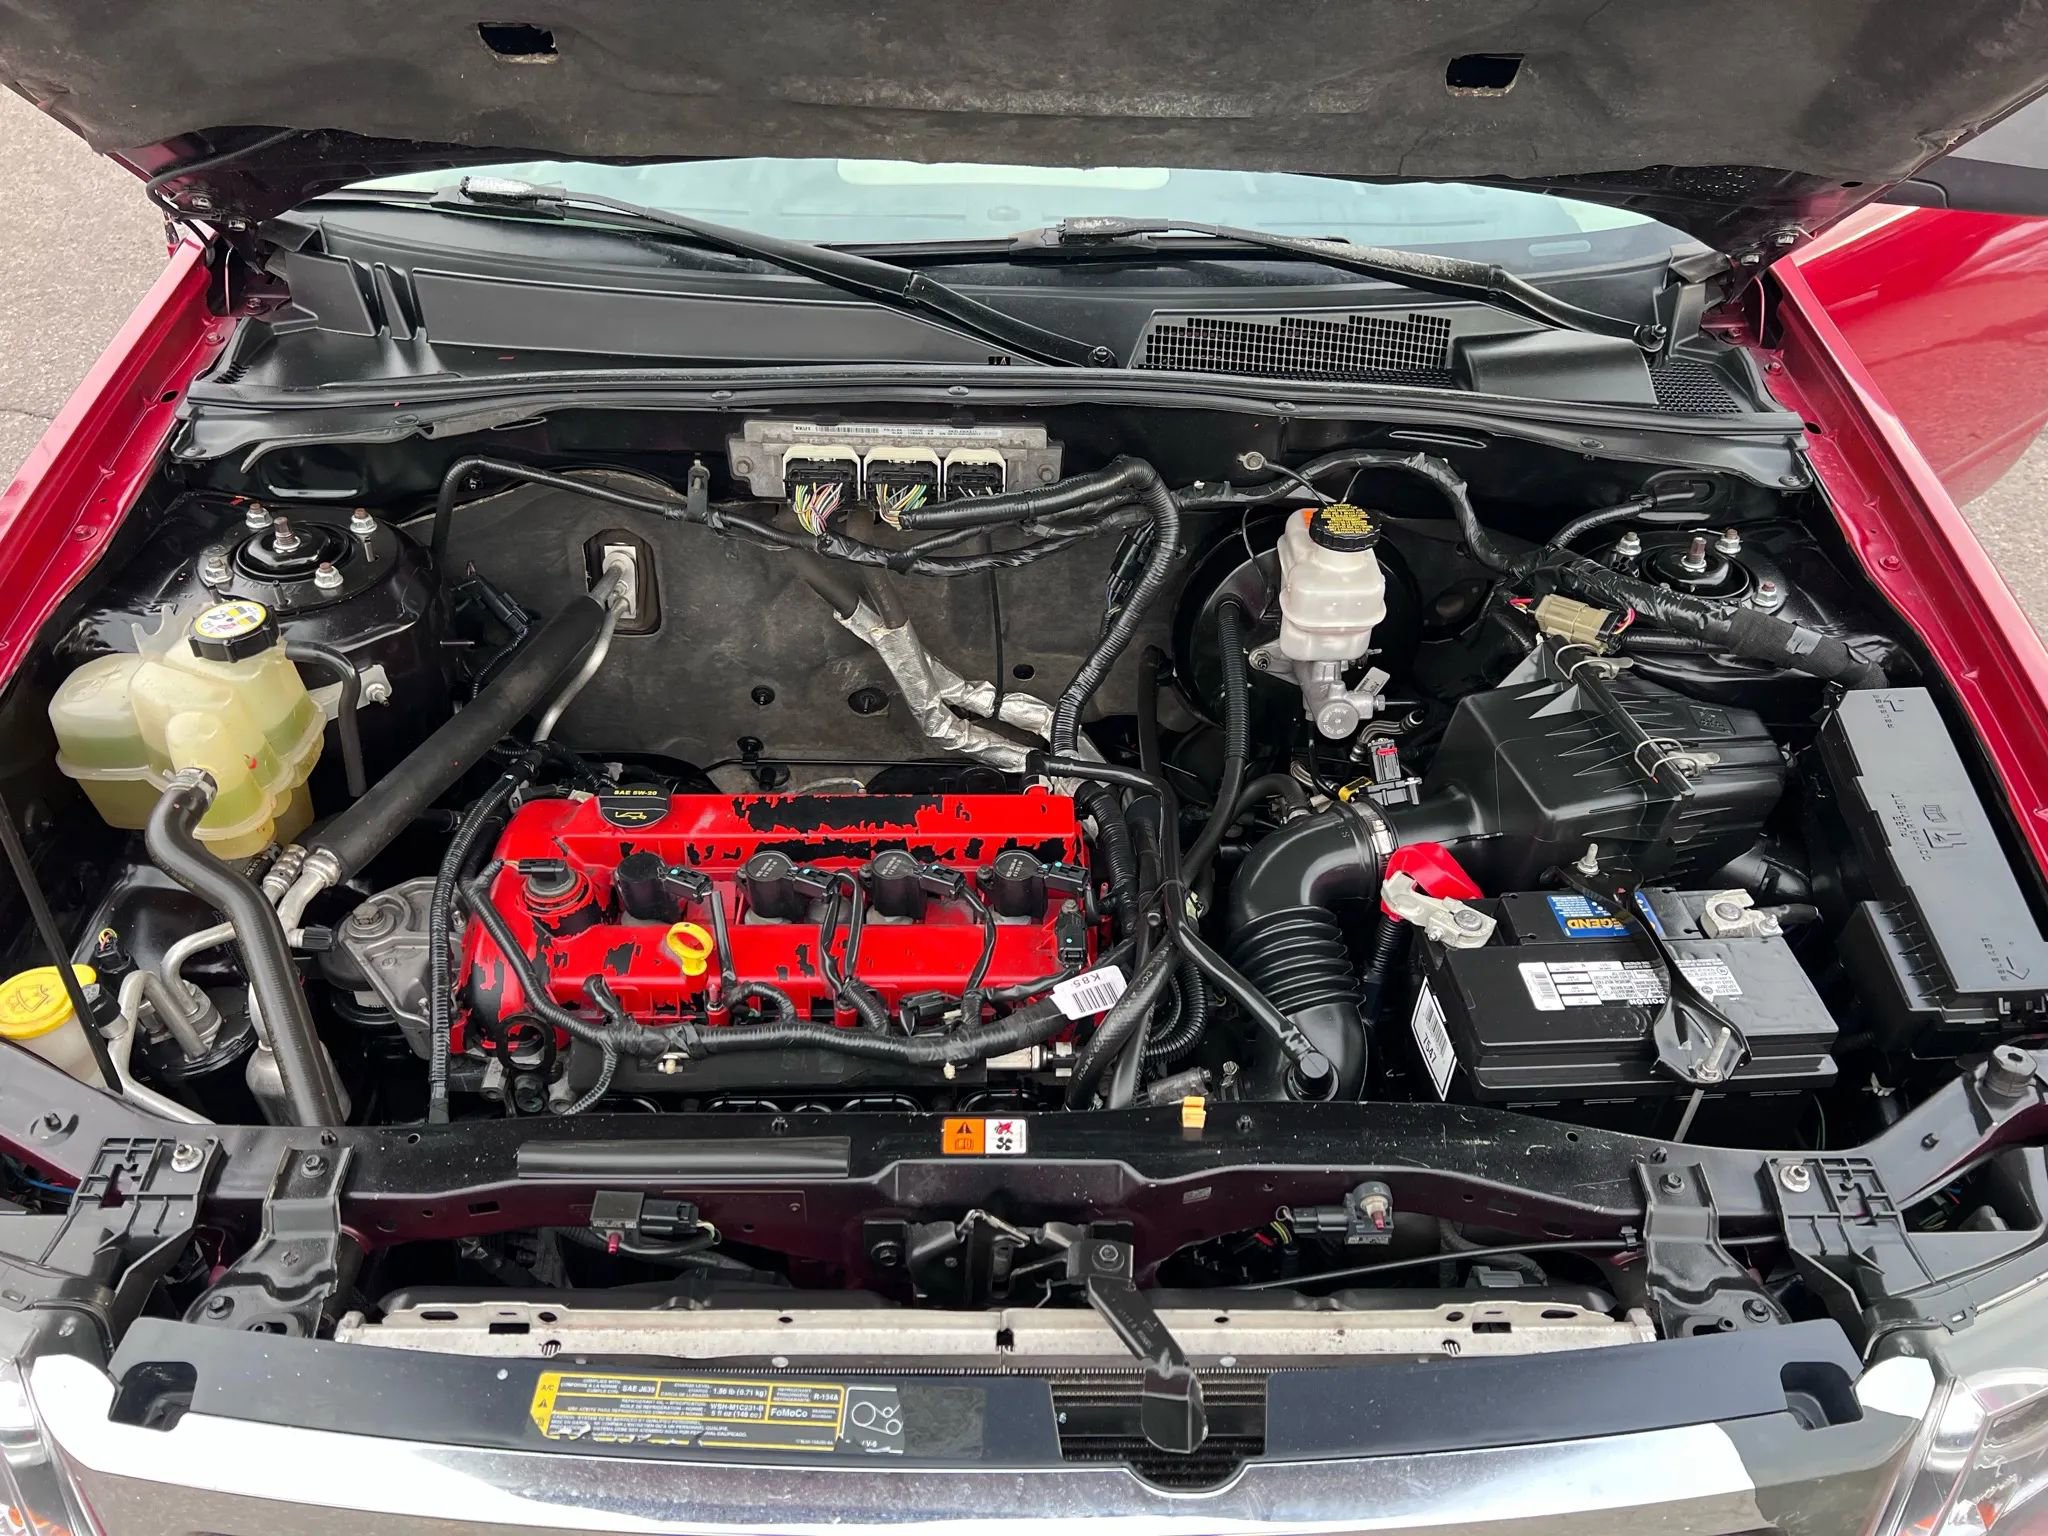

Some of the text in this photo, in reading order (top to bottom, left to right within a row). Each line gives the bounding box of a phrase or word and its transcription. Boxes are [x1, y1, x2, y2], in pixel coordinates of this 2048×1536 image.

[1892, 815, 1909, 838] FUSE
[1566, 917, 1621, 930] EGEND
[1072, 972, 1101, 988] K85
[1422, 1032, 1437, 1064] 7547
[622, 1384, 656, 1393] SAE J639
[813, 1393, 839, 1401] R-134A
[770, 1408, 808, 1418] FoMoCo
